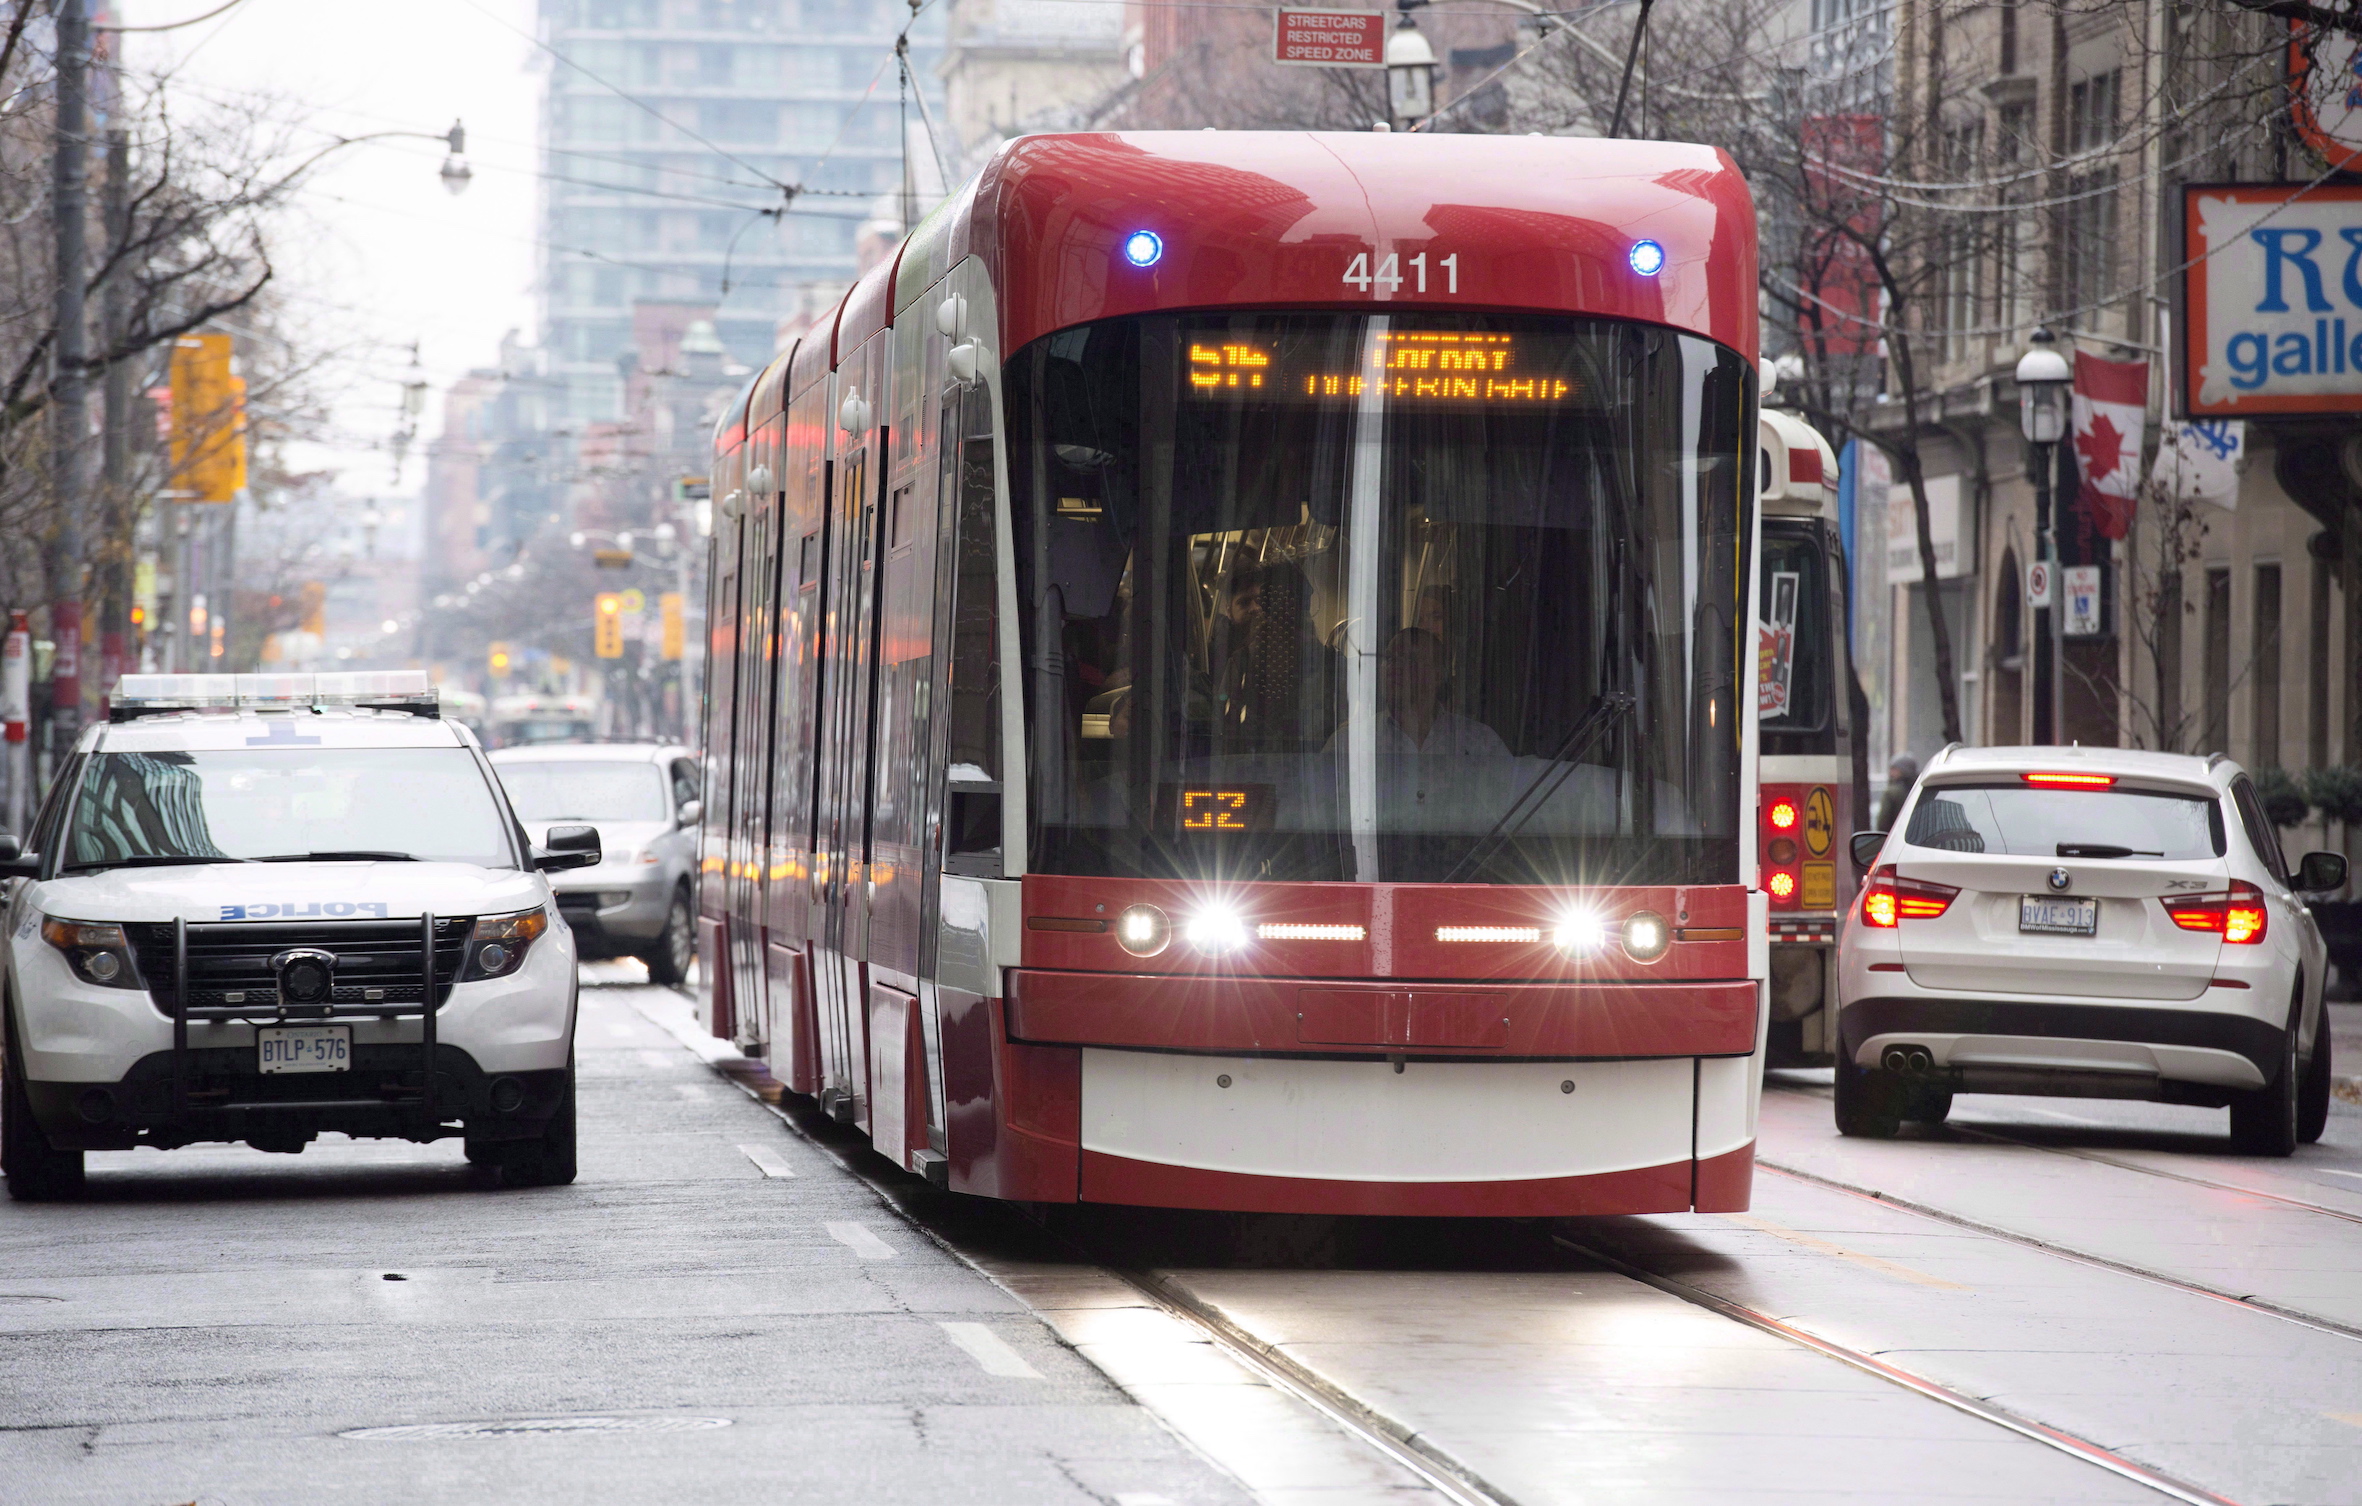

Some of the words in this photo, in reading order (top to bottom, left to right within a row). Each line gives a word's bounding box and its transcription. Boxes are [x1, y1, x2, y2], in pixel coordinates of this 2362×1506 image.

[1287, 14, 1367, 29] STREETCARS
[1286, 30, 1363, 45] RESTRICTED
[1286, 45, 1333, 59] SPEED
[1335, 47, 1374, 61] ZONE
[1342, 252, 1457, 294] 4411
[2165, 880, 2208, 889] X3
[2023, 905, 2058, 925] BVAE
[2067, 907, 2094, 926] 913
[263, 1039, 305, 1062] BTLP
[315, 1038, 346, 1061] 576
